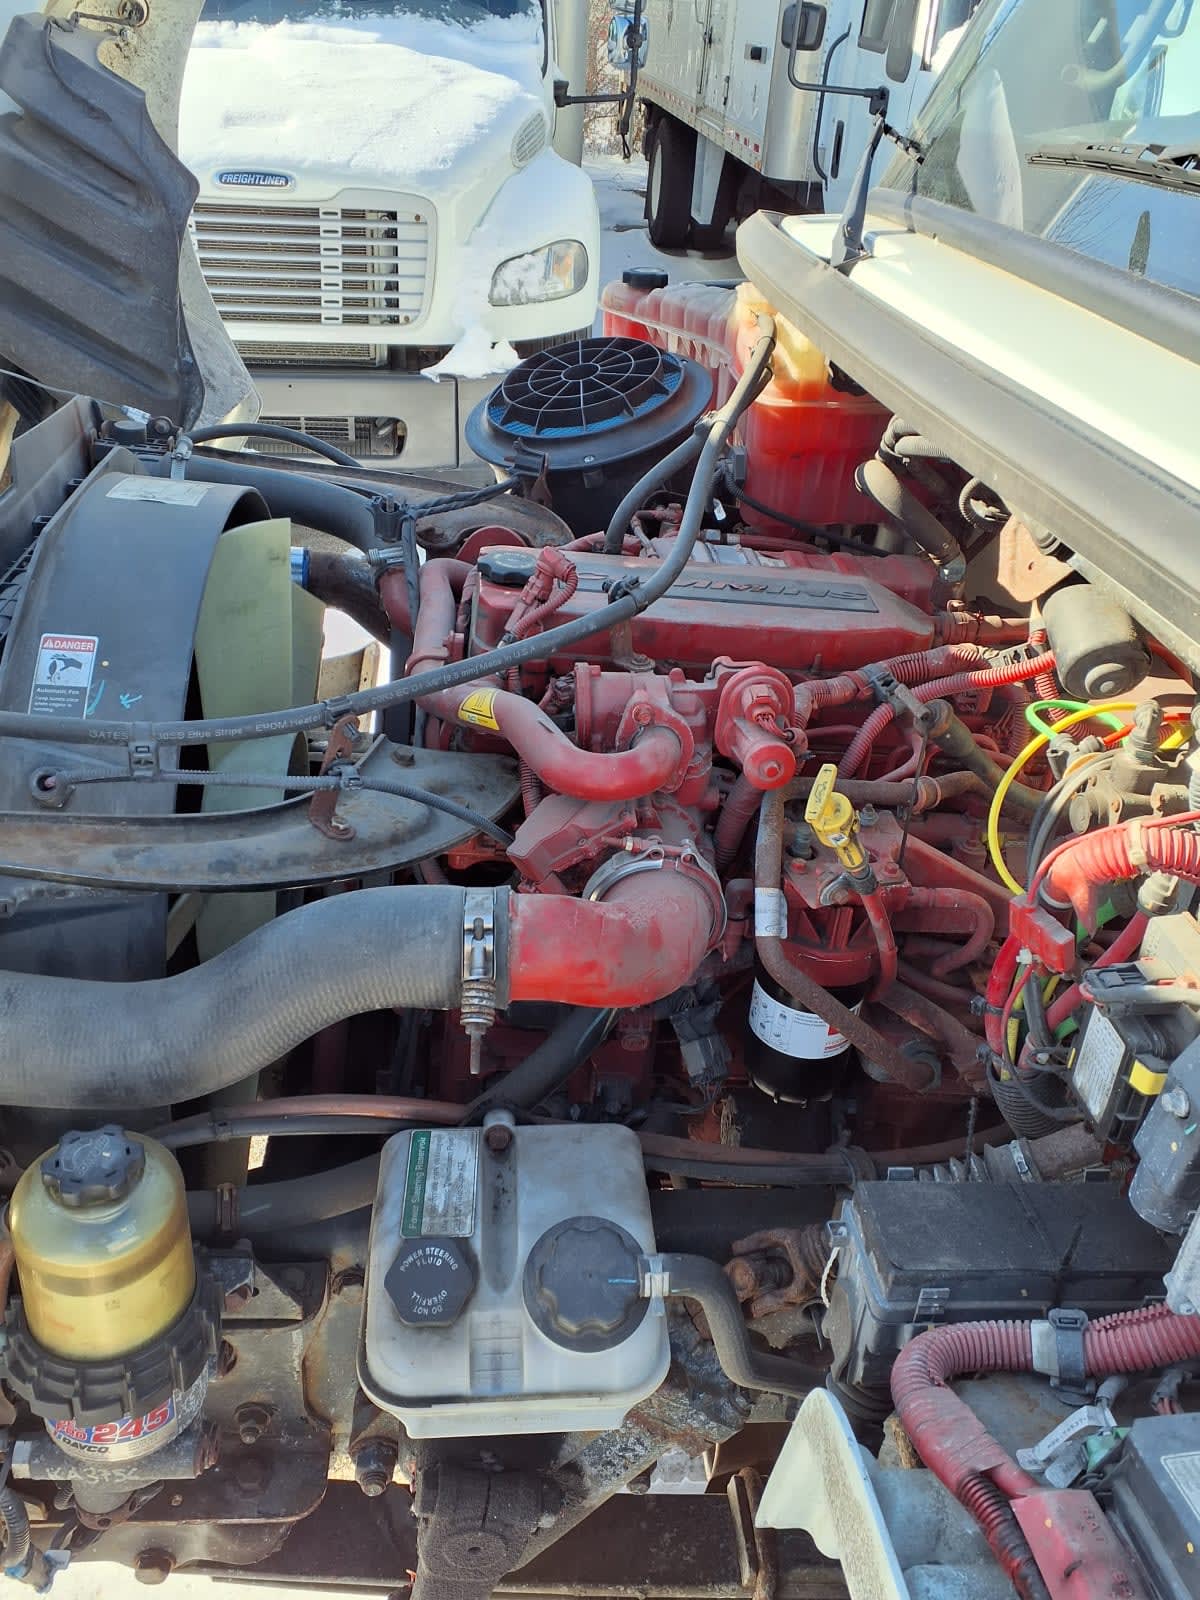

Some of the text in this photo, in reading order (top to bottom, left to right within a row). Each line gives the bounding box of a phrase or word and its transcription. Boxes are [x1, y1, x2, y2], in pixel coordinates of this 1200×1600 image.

[221, 173, 286, 186] FREIGHTLINER
[54, 640, 94, 651] DANGER
[89, 728, 129, 740] GATES
[400, 1247, 459, 1272] POWER STEERING
[415, 1256, 442, 1267] FLUID
[411, 1289, 448, 1306] OVERFILL
[413, 1305, 443, 1316] DO NOT
[90, 1402, 170, 1443] 245
[62, 1438, 109, 1454] DAVCO
